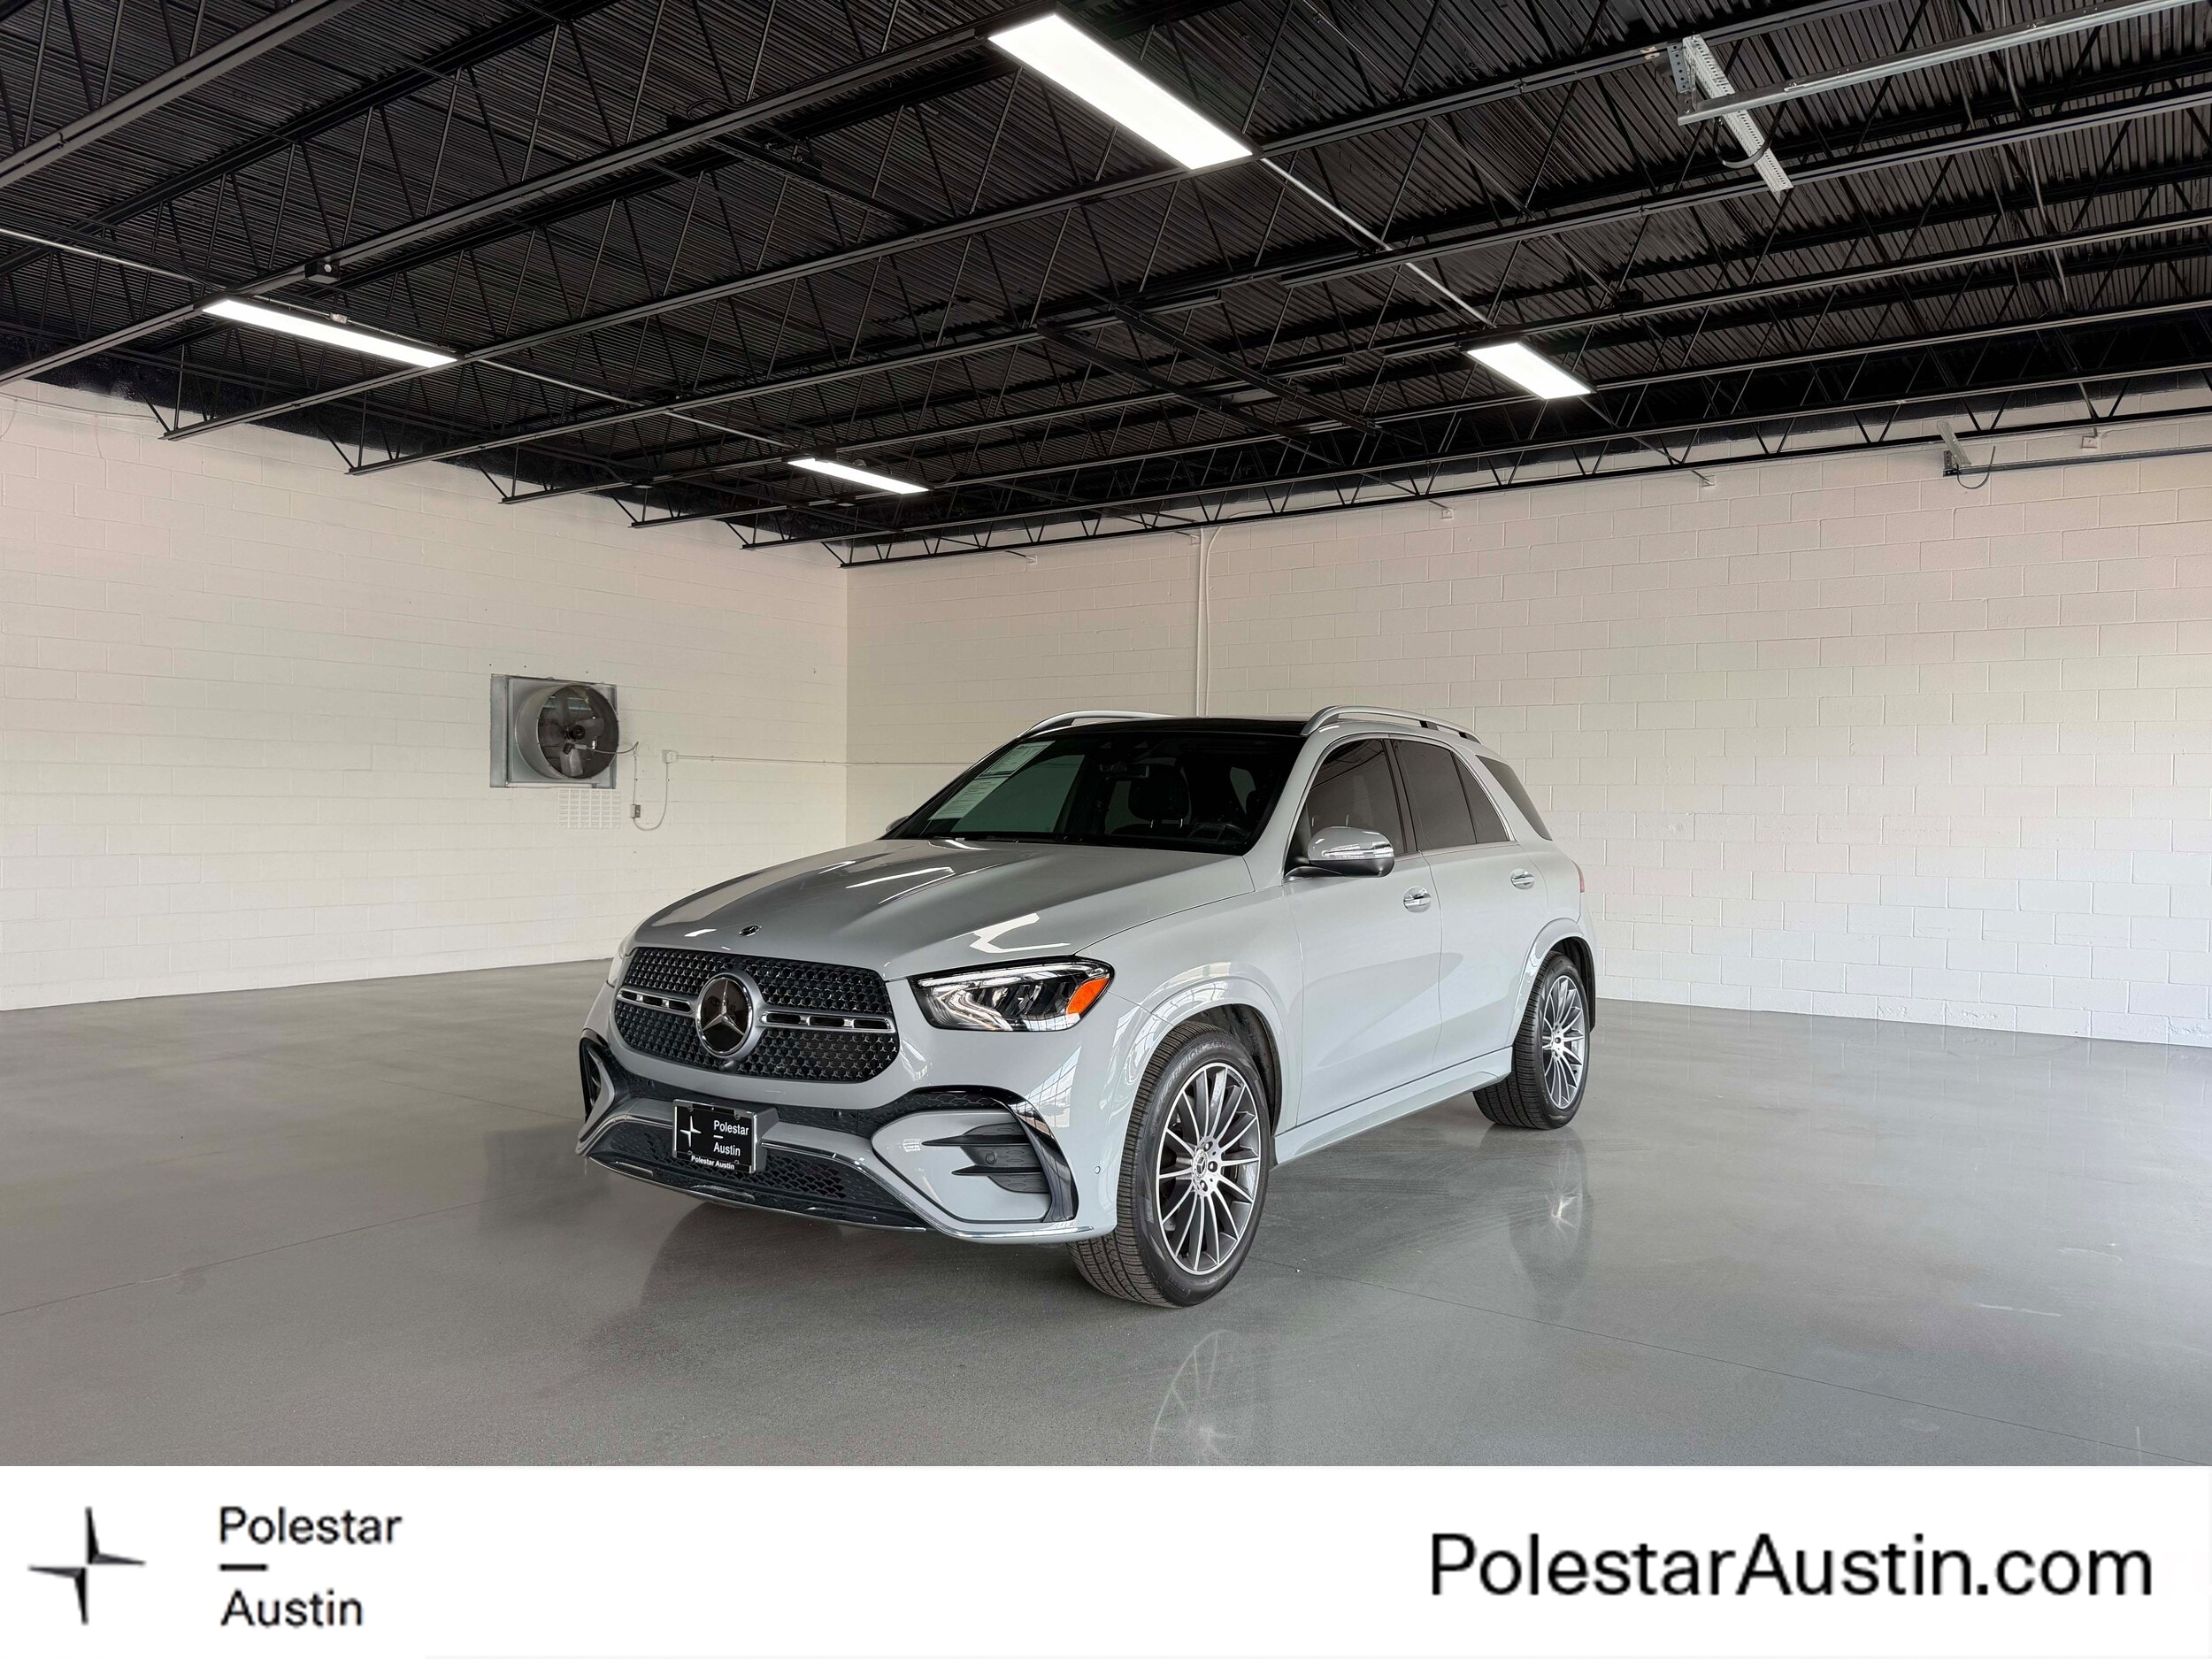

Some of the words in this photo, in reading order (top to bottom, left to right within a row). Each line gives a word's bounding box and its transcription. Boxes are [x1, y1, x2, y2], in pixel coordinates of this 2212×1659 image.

[713, 1120, 749, 1135] Polestar
[713, 1141, 741, 1156] Austin
[691, 1155, 715, 1165] Polestar
[715, 1160, 734, 1170] Austin
